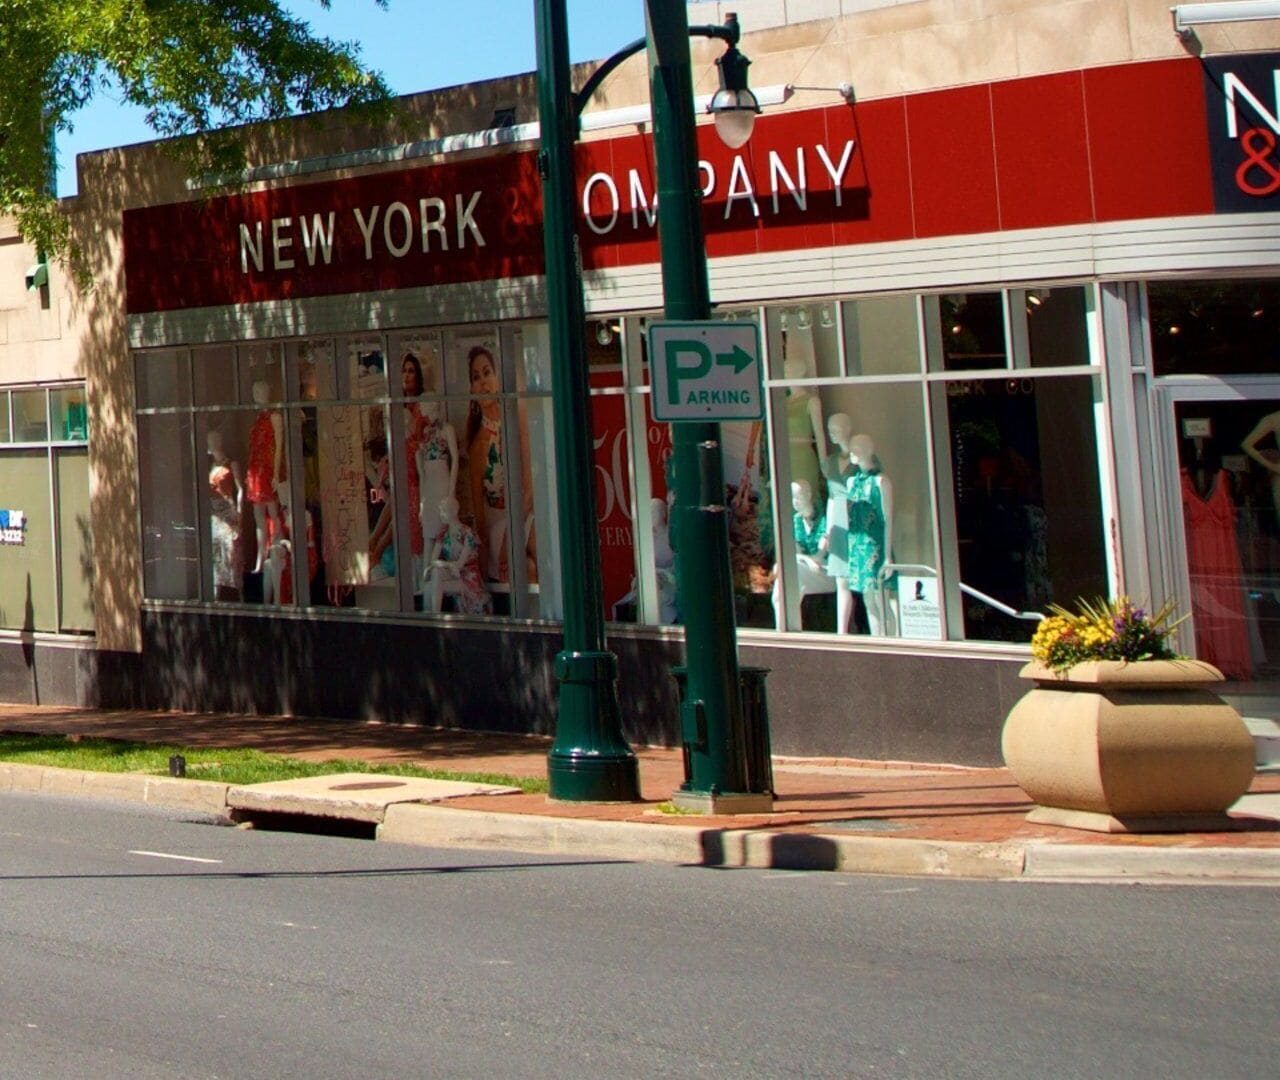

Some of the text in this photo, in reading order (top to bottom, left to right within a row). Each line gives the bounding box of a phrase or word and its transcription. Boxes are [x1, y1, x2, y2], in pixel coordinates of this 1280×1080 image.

[238, 211, 336, 274] NEW
[352, 191, 487, 261] YORK
[582, 139, 856, 235] OMPANY
